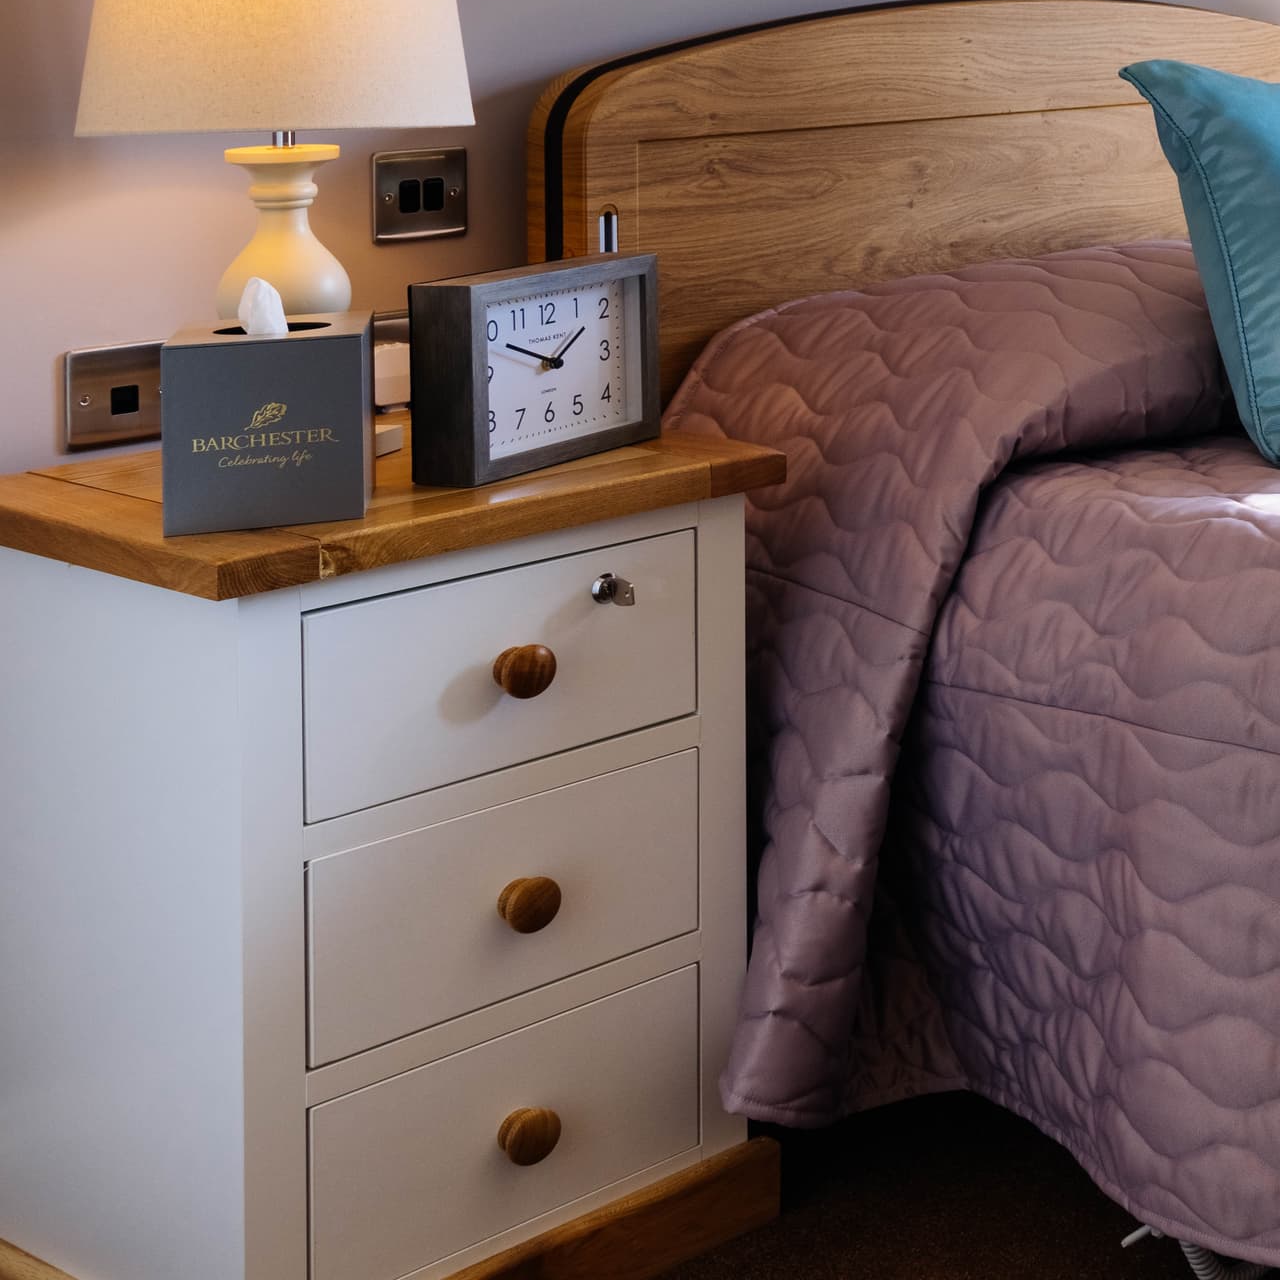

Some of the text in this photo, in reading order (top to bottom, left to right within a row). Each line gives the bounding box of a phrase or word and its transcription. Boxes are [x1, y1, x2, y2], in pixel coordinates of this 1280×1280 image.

[538, 302, 556, 326] 12
[573, 298, 579, 319] 1
[598, 297, 609, 319] 2
[486, 320, 498, 342] 0
[511, 308, 525, 332] 11
[528, 336, 552, 345] THOMAS
[600, 340, 610, 361] 3
[601, 382, 611, 403] 4
[544, 401, 555, 423] 6
[572, 394, 584, 416] 5
[515, 408, 526, 430] 7
[192, 428, 340, 453] BARCHESTER
[218, 449, 313, 469] Celebrating life
